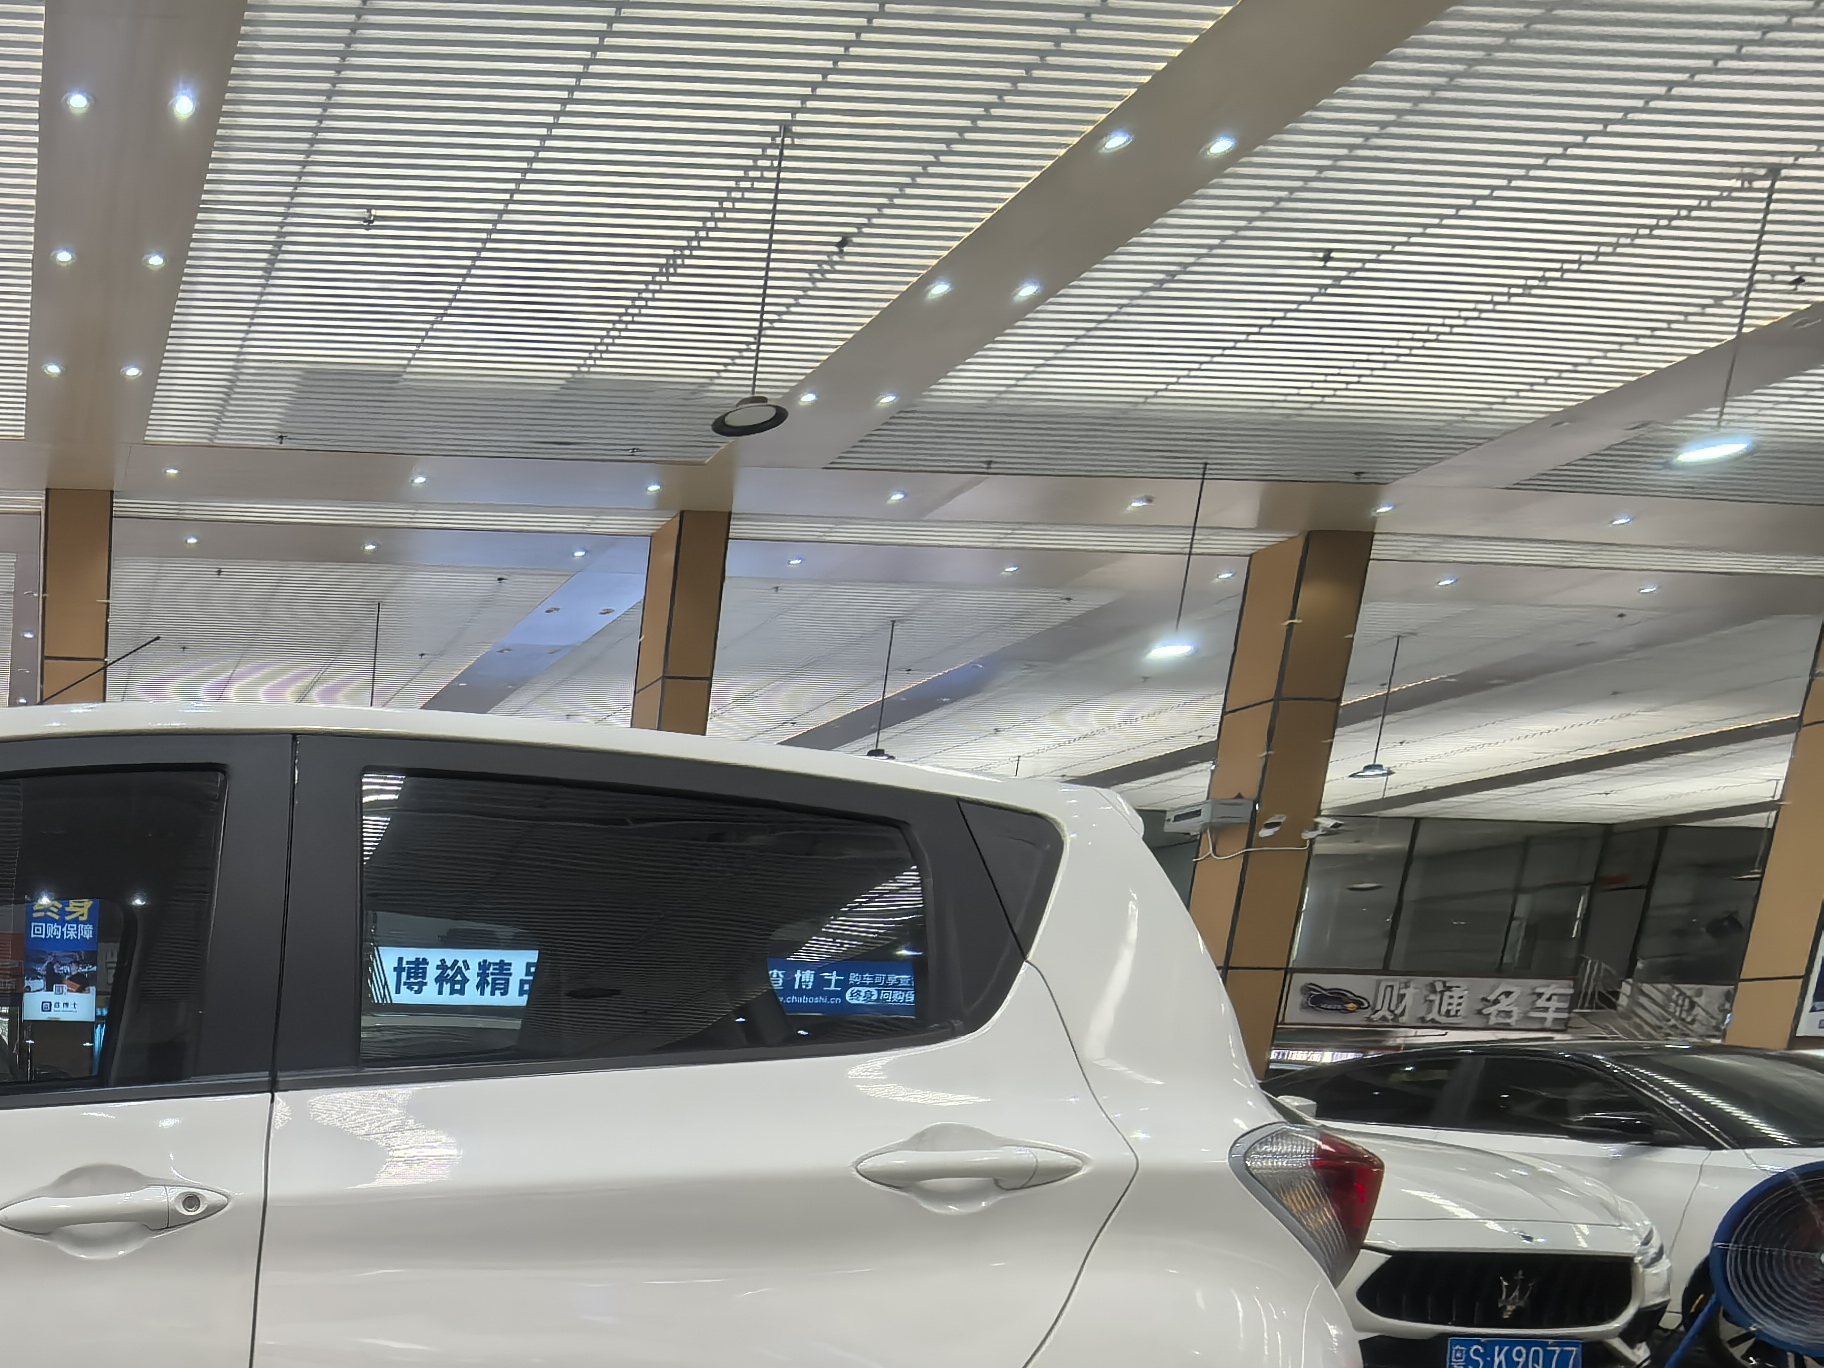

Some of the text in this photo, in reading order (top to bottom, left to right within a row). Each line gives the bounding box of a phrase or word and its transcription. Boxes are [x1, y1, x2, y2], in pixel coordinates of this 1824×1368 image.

[31, 922, 94, 940] 回购保障
[848, 972, 915, 987] 购车可享查
[1370, 979, 1574, 1028] 财通名车
